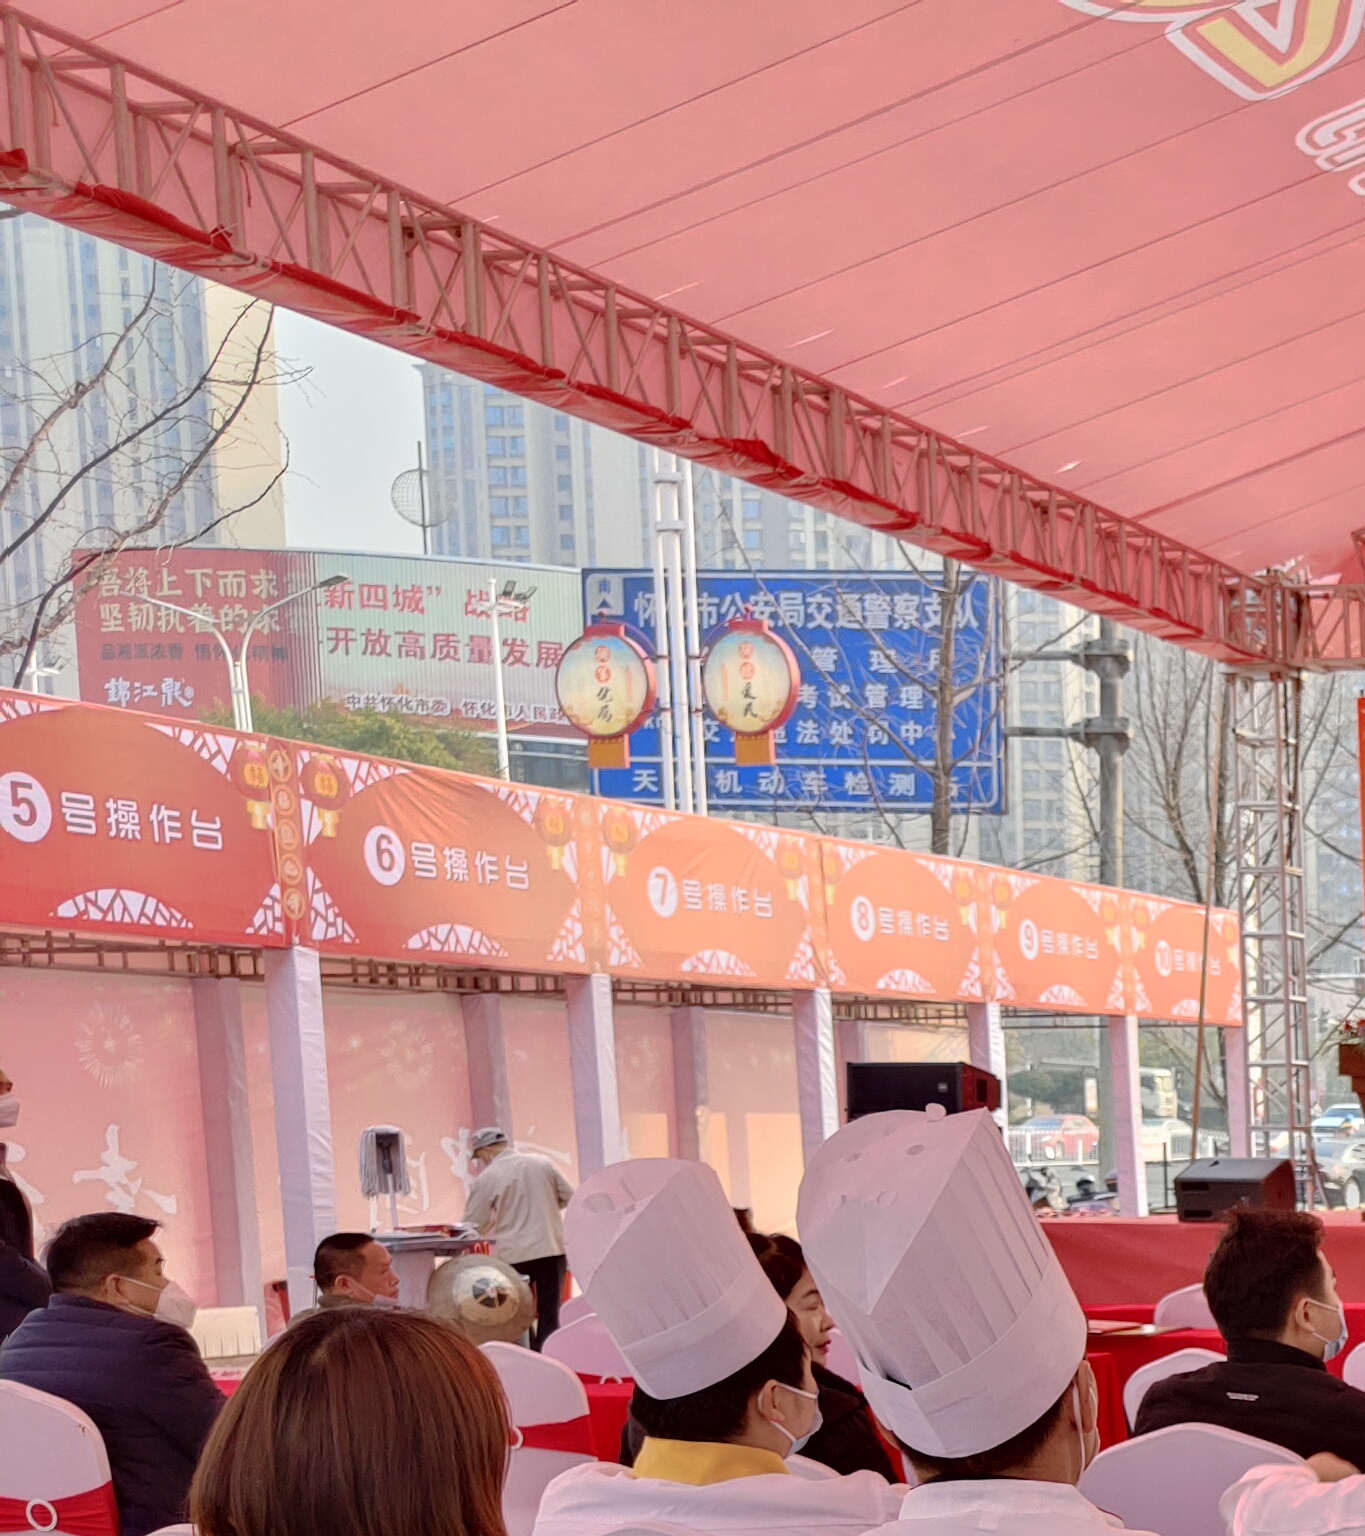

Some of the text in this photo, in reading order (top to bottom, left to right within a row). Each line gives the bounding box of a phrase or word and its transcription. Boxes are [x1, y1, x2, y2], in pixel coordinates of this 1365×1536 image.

[633, 590, 978, 630] 怀市公安局交通警察支队
